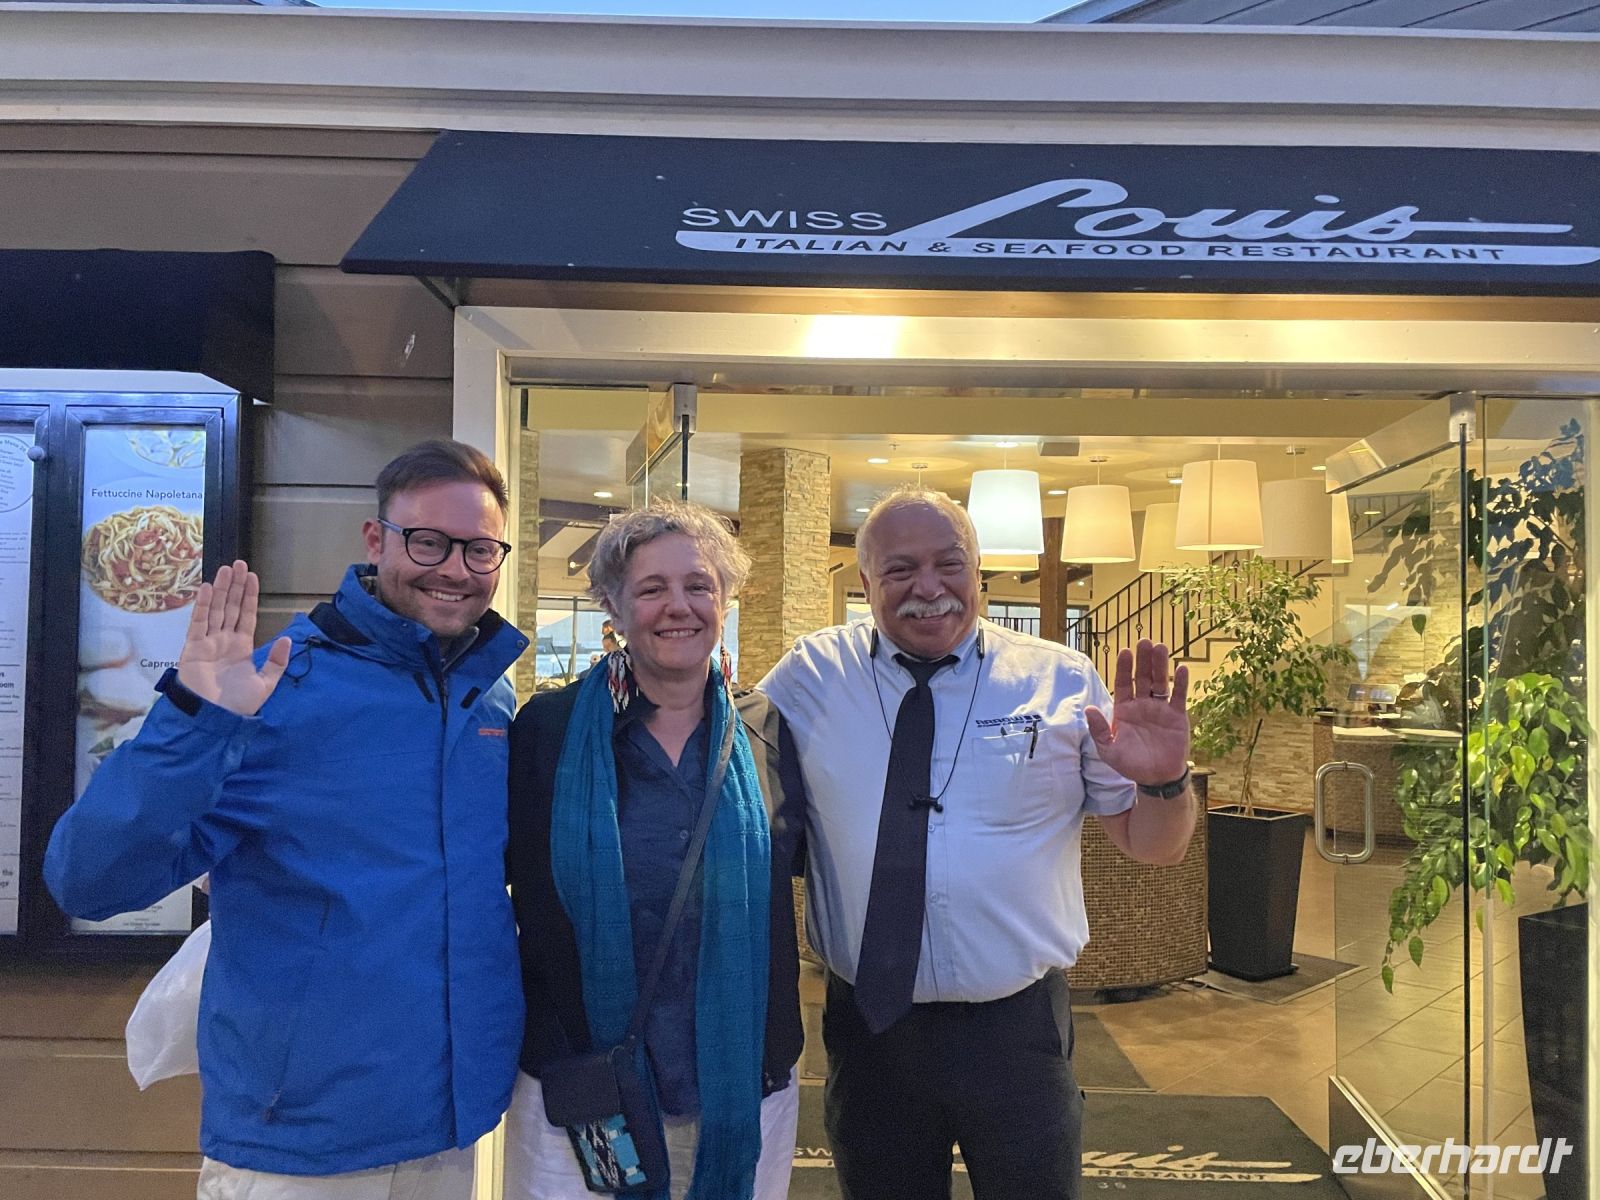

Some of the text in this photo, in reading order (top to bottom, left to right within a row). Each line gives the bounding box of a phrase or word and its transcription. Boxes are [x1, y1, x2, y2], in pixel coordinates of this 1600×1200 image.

[681, 178, 1574, 241] SWISS Louis
[735, 238, 1505, 260] ITALIAN & SEAFOOD RESTAURANT
[91, 488, 203, 500] Fettuccine Napoletana
[1098, 1169, 1267, 1181] RESTAURANT
